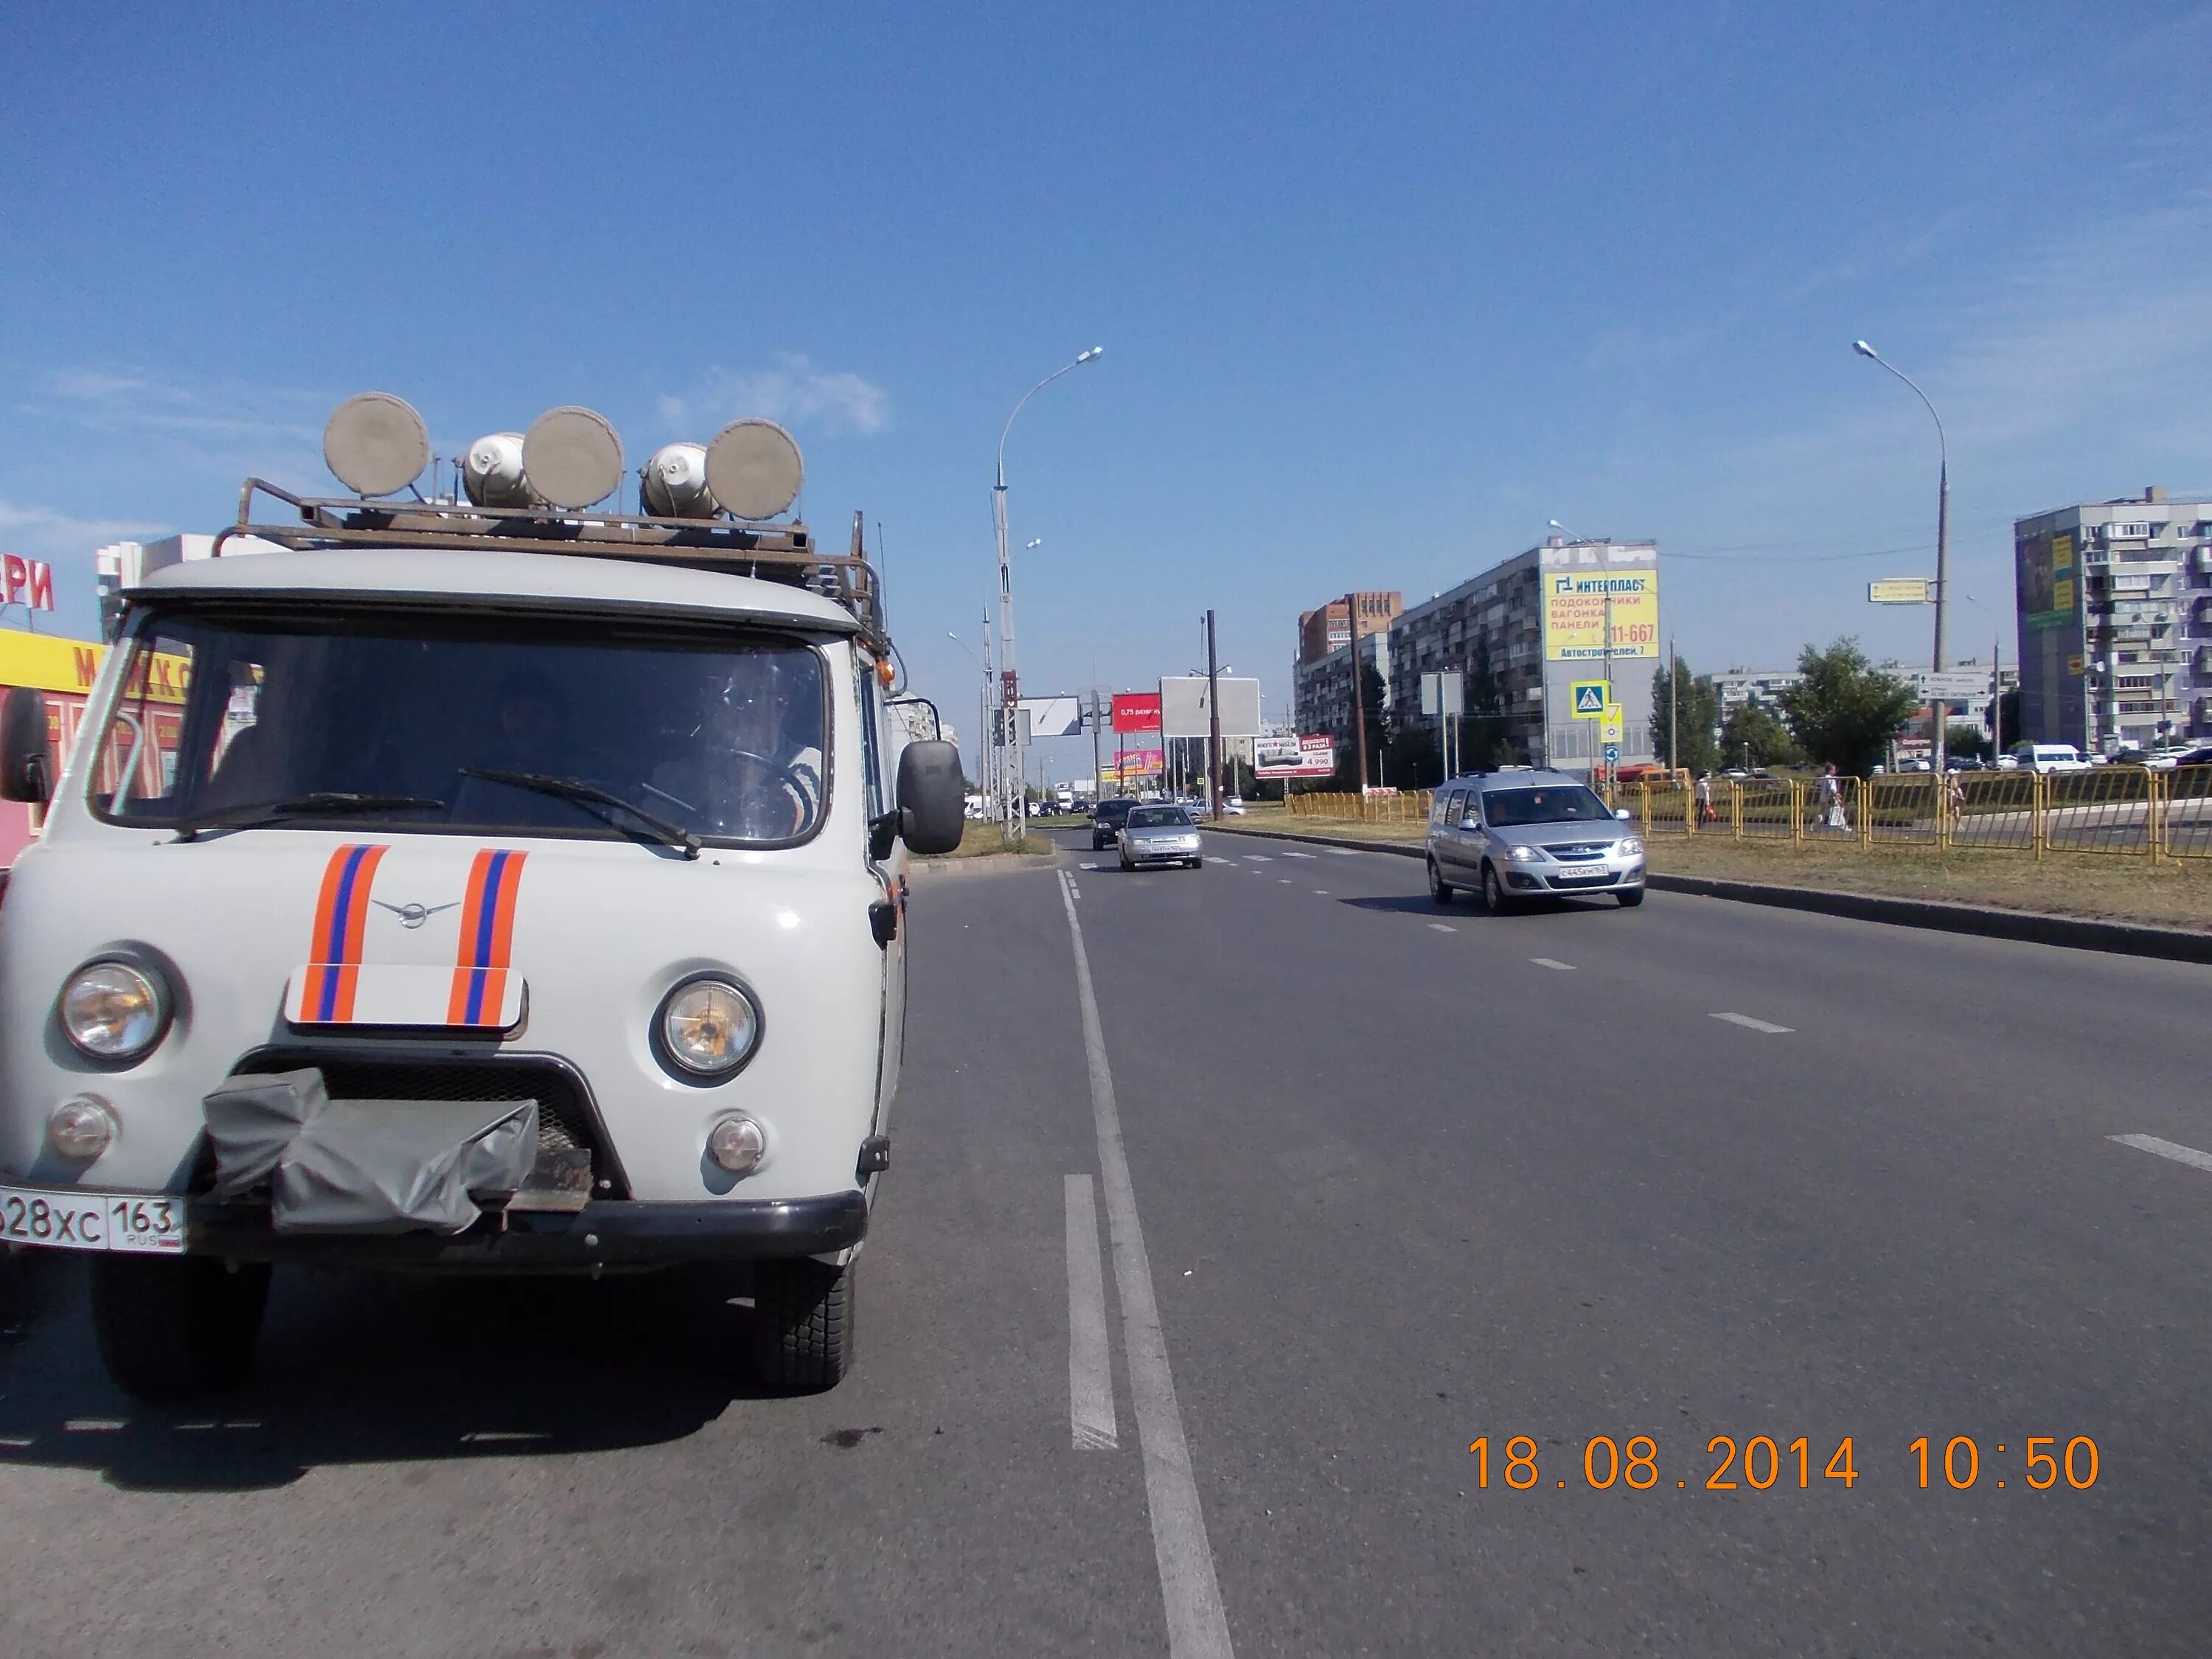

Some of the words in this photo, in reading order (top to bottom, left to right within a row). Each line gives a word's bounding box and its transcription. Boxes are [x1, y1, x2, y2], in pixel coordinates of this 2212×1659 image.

[0, 553, 54, 611] РИ
[1576, 579, 1646, 593] ИНТЕРПЛАСТ
[1551, 611, 1606, 619] ВАГОНКА
[1551, 621, 1599, 630] ПАНЕЛИ
[1561, 647, 1638, 658] Автостроелей,
[128, 1234, 158, 1246] RUS
